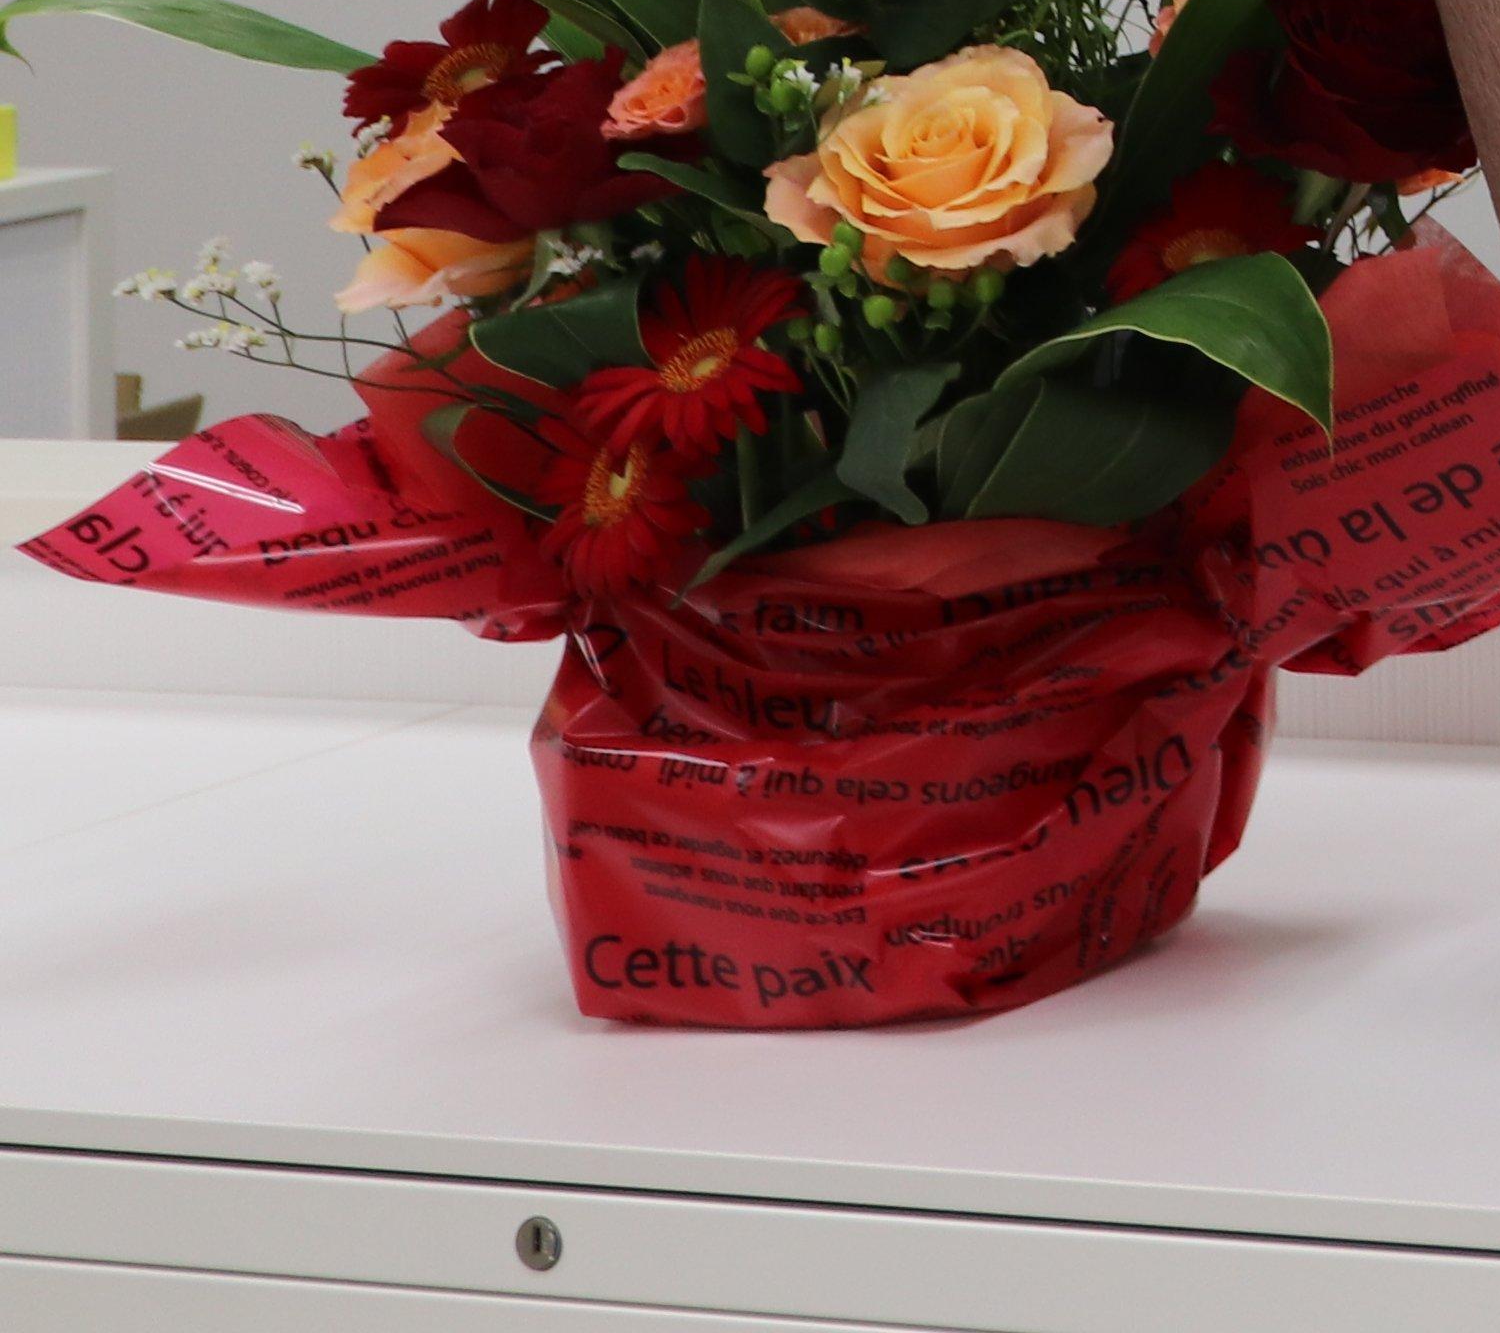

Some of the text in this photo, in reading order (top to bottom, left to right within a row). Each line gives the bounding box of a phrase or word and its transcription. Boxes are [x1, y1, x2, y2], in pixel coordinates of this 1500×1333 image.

[836, 772, 910, 804] cela
[582, 931, 875, 1008] Cette paix
